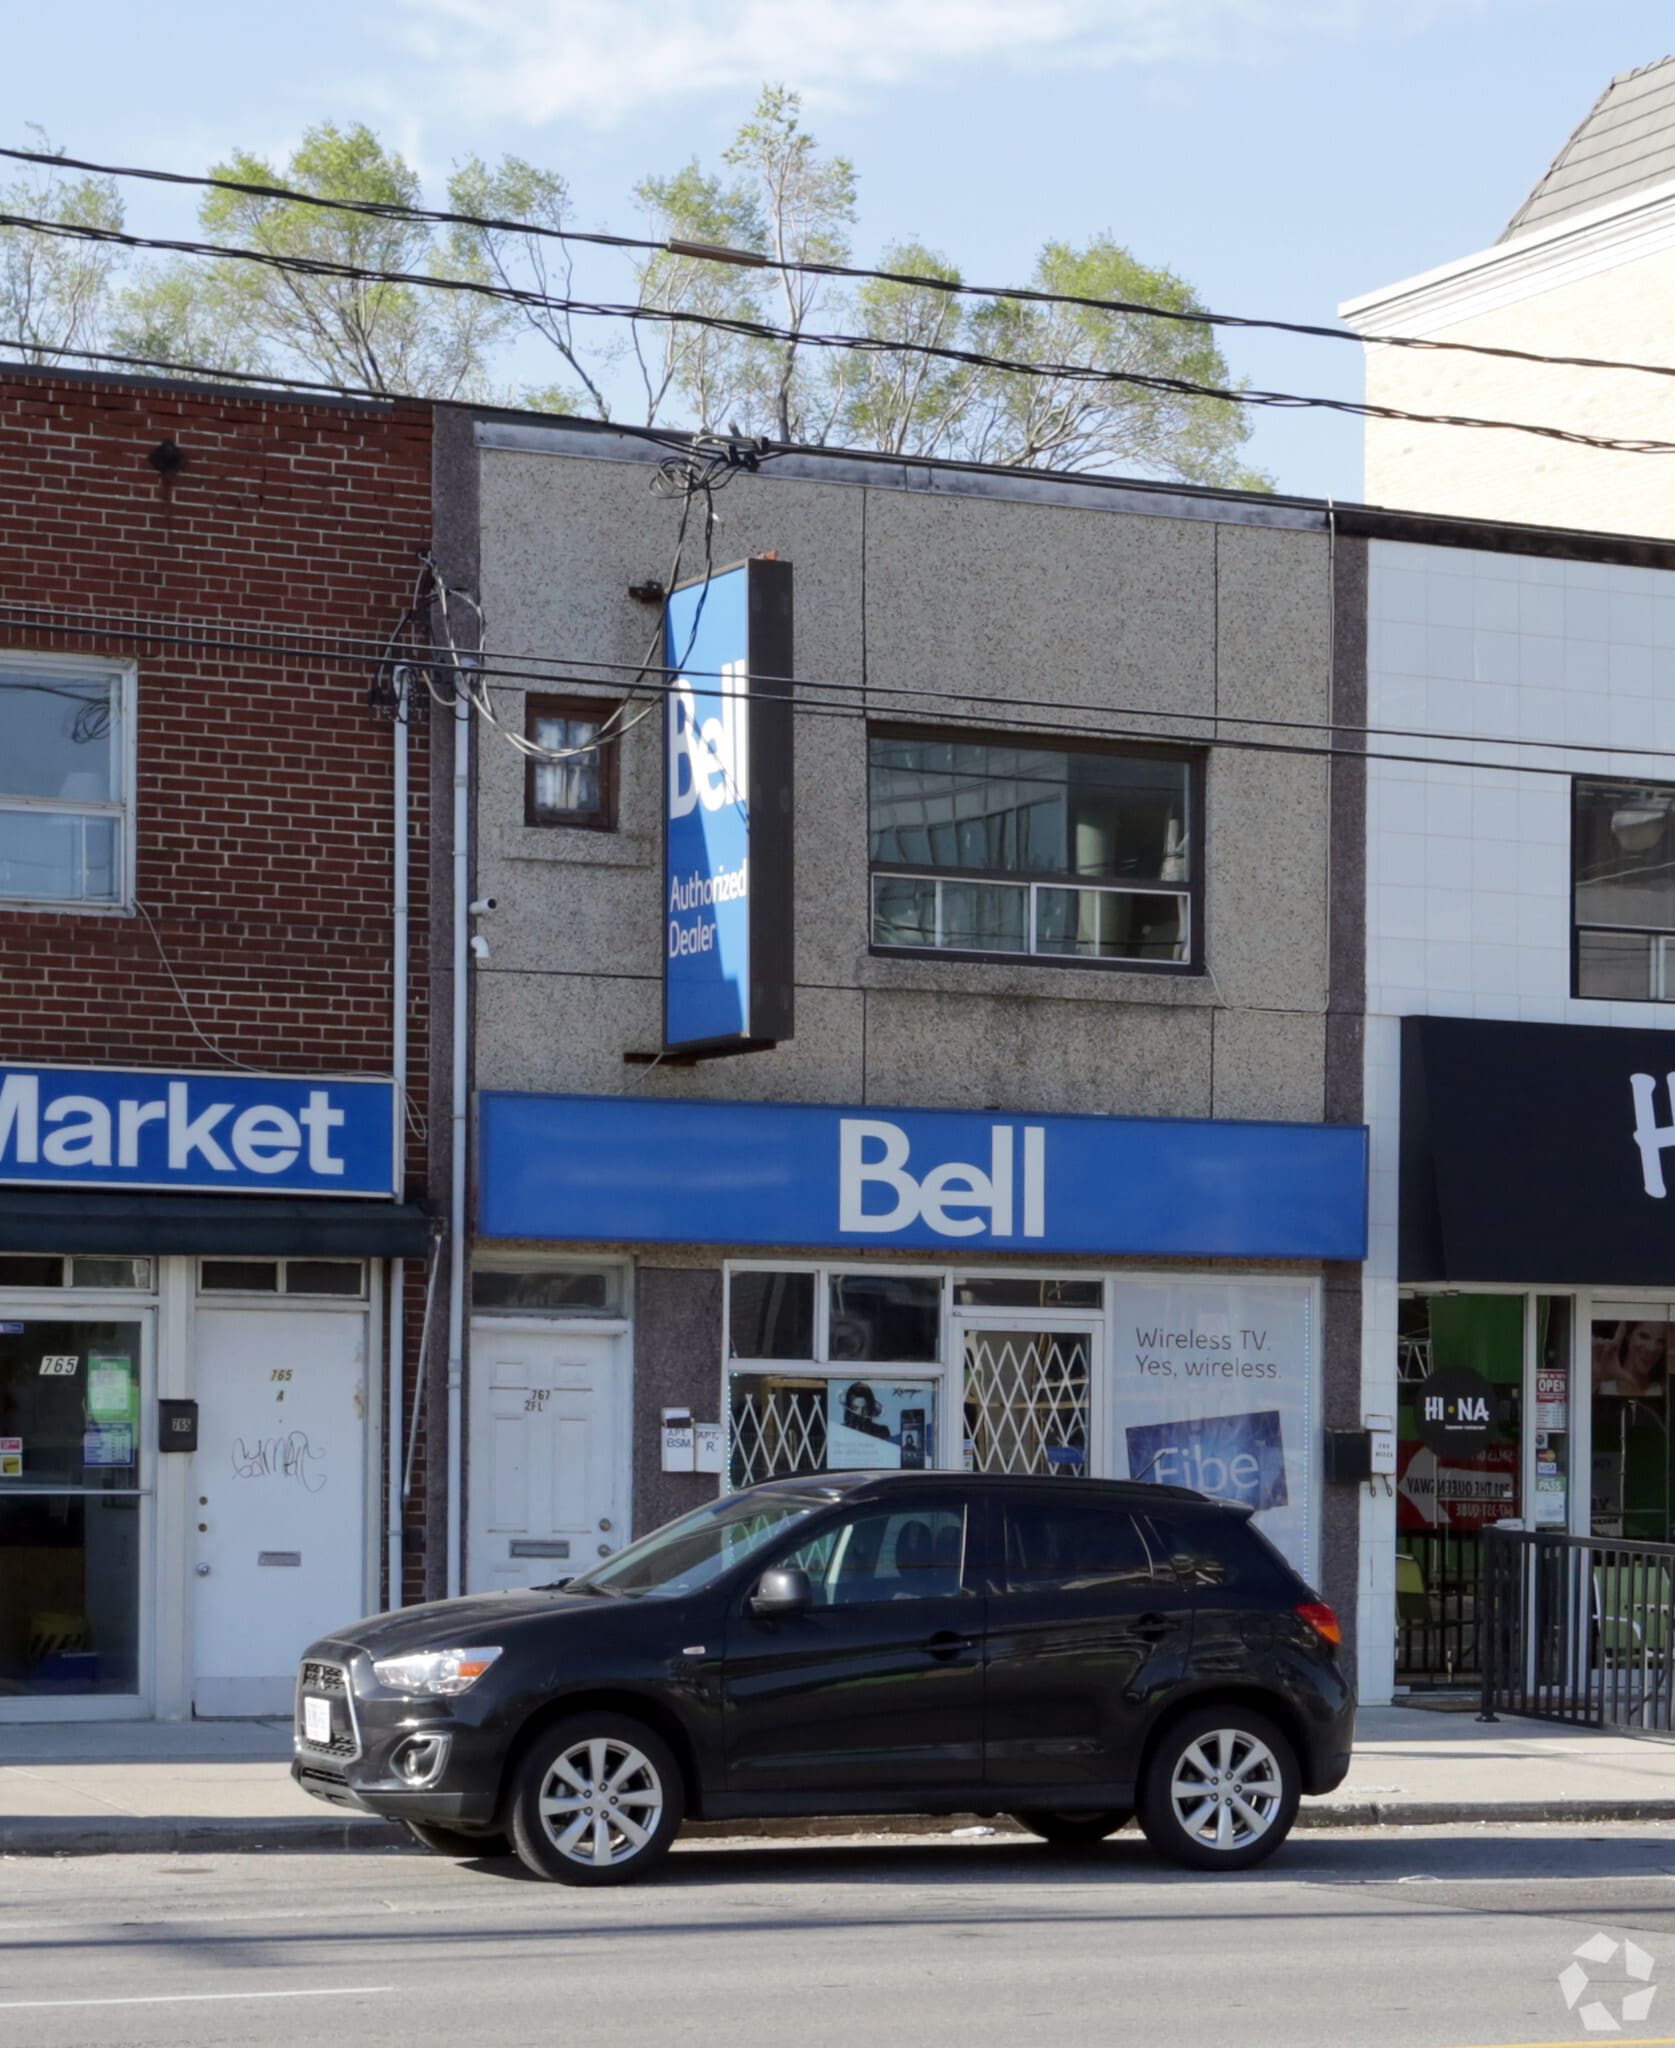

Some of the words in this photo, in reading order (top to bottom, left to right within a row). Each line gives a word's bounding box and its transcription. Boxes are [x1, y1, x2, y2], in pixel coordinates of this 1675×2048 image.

[668, 659, 748, 819] Bell
[669, 858, 748, 912] Authorized
[669, 915, 717, 958] Dealer
[840, 1118, 1045, 1237] Bell
[1136, 1327, 1232, 1350] Wireless
[43, 1357, 77, 1374] 765
[270, 1369, 293, 1382] 765
[1136, 1354, 1178, 1380] Yes,
[275, 1389, 285, 1402] A
[531, 1389, 551, 1401] 767
[1538, 1379, 1566, 1393] OPEN
[1154, 1444, 1260, 1493] Fibe
